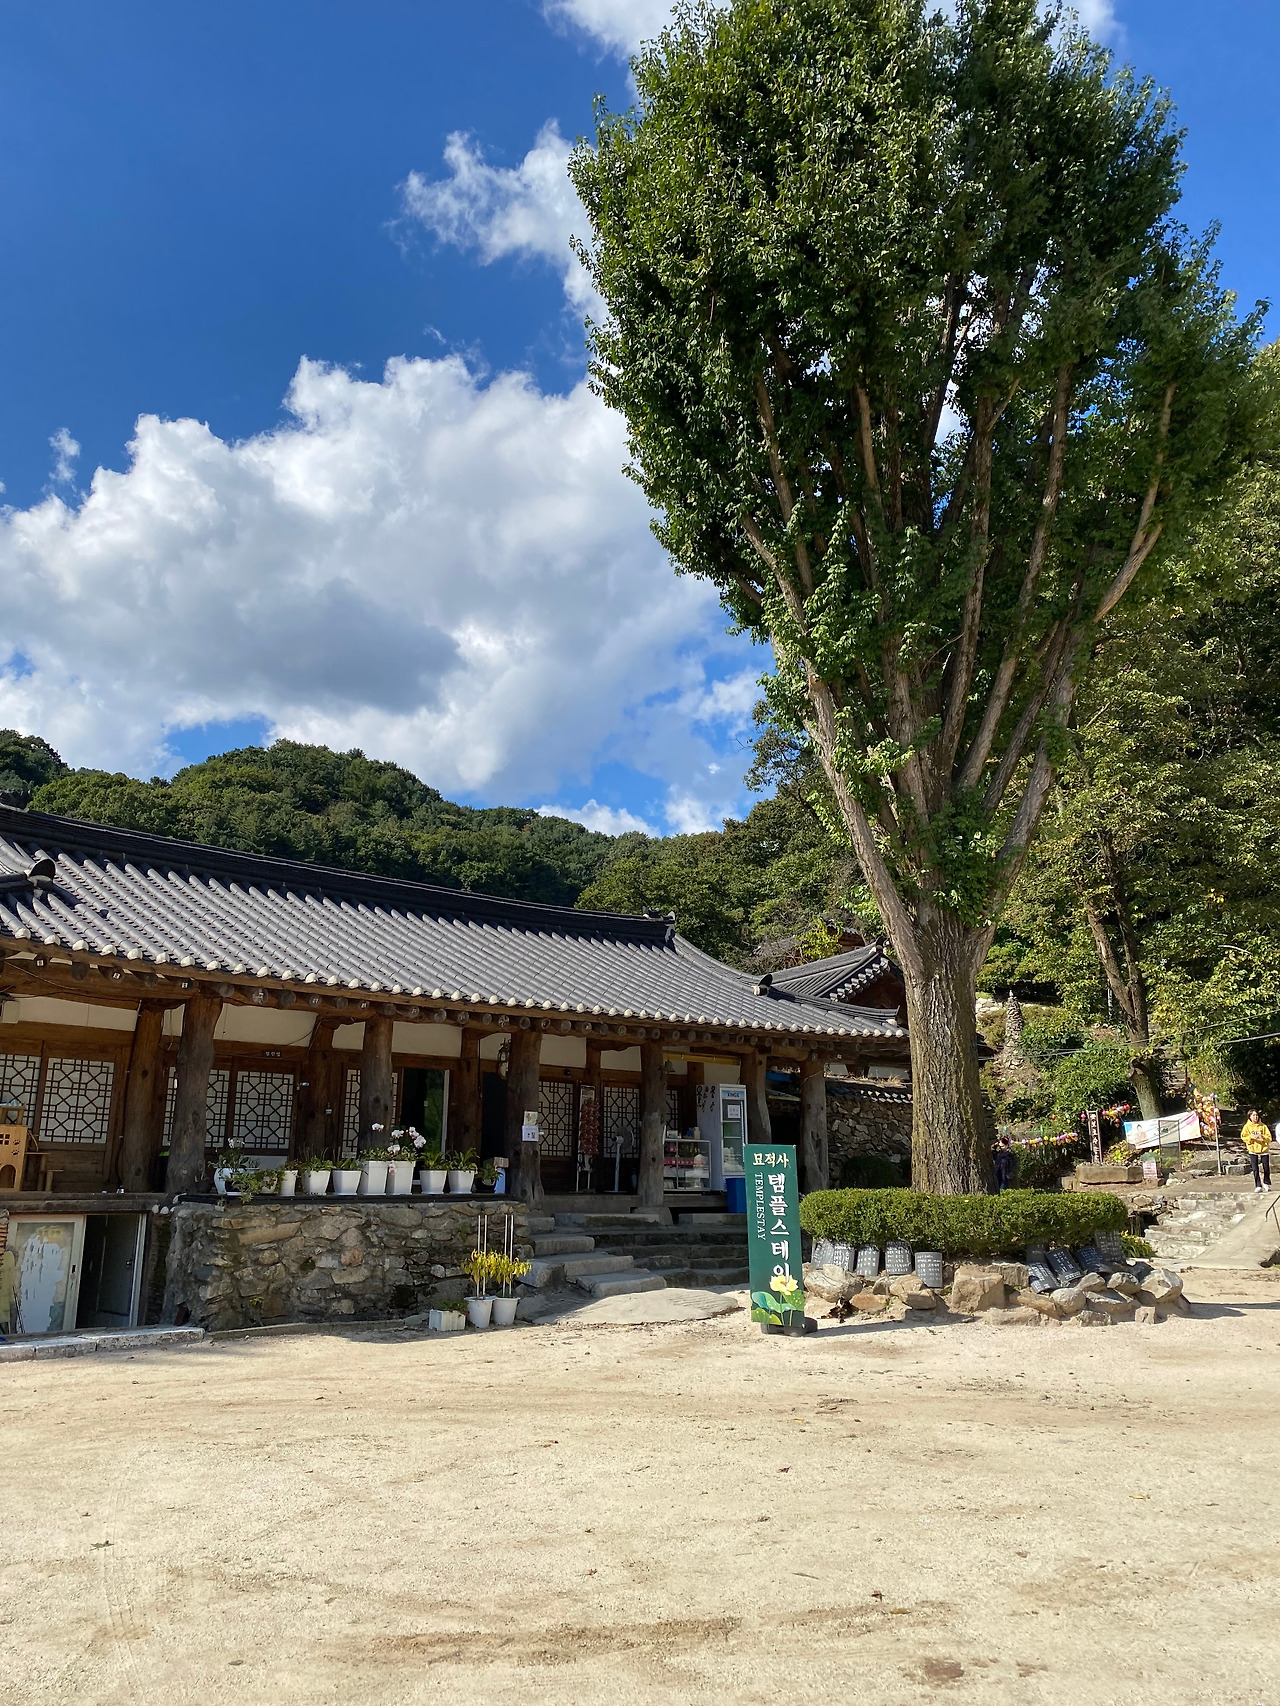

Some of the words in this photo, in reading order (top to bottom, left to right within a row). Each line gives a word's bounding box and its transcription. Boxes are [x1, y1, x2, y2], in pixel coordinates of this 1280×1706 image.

[752, 1152, 789, 1168] 묘적사
[754, 1171, 766, 1241] TEMPLESTAY
[767, 1172, 791, 1283] 템플스테이
